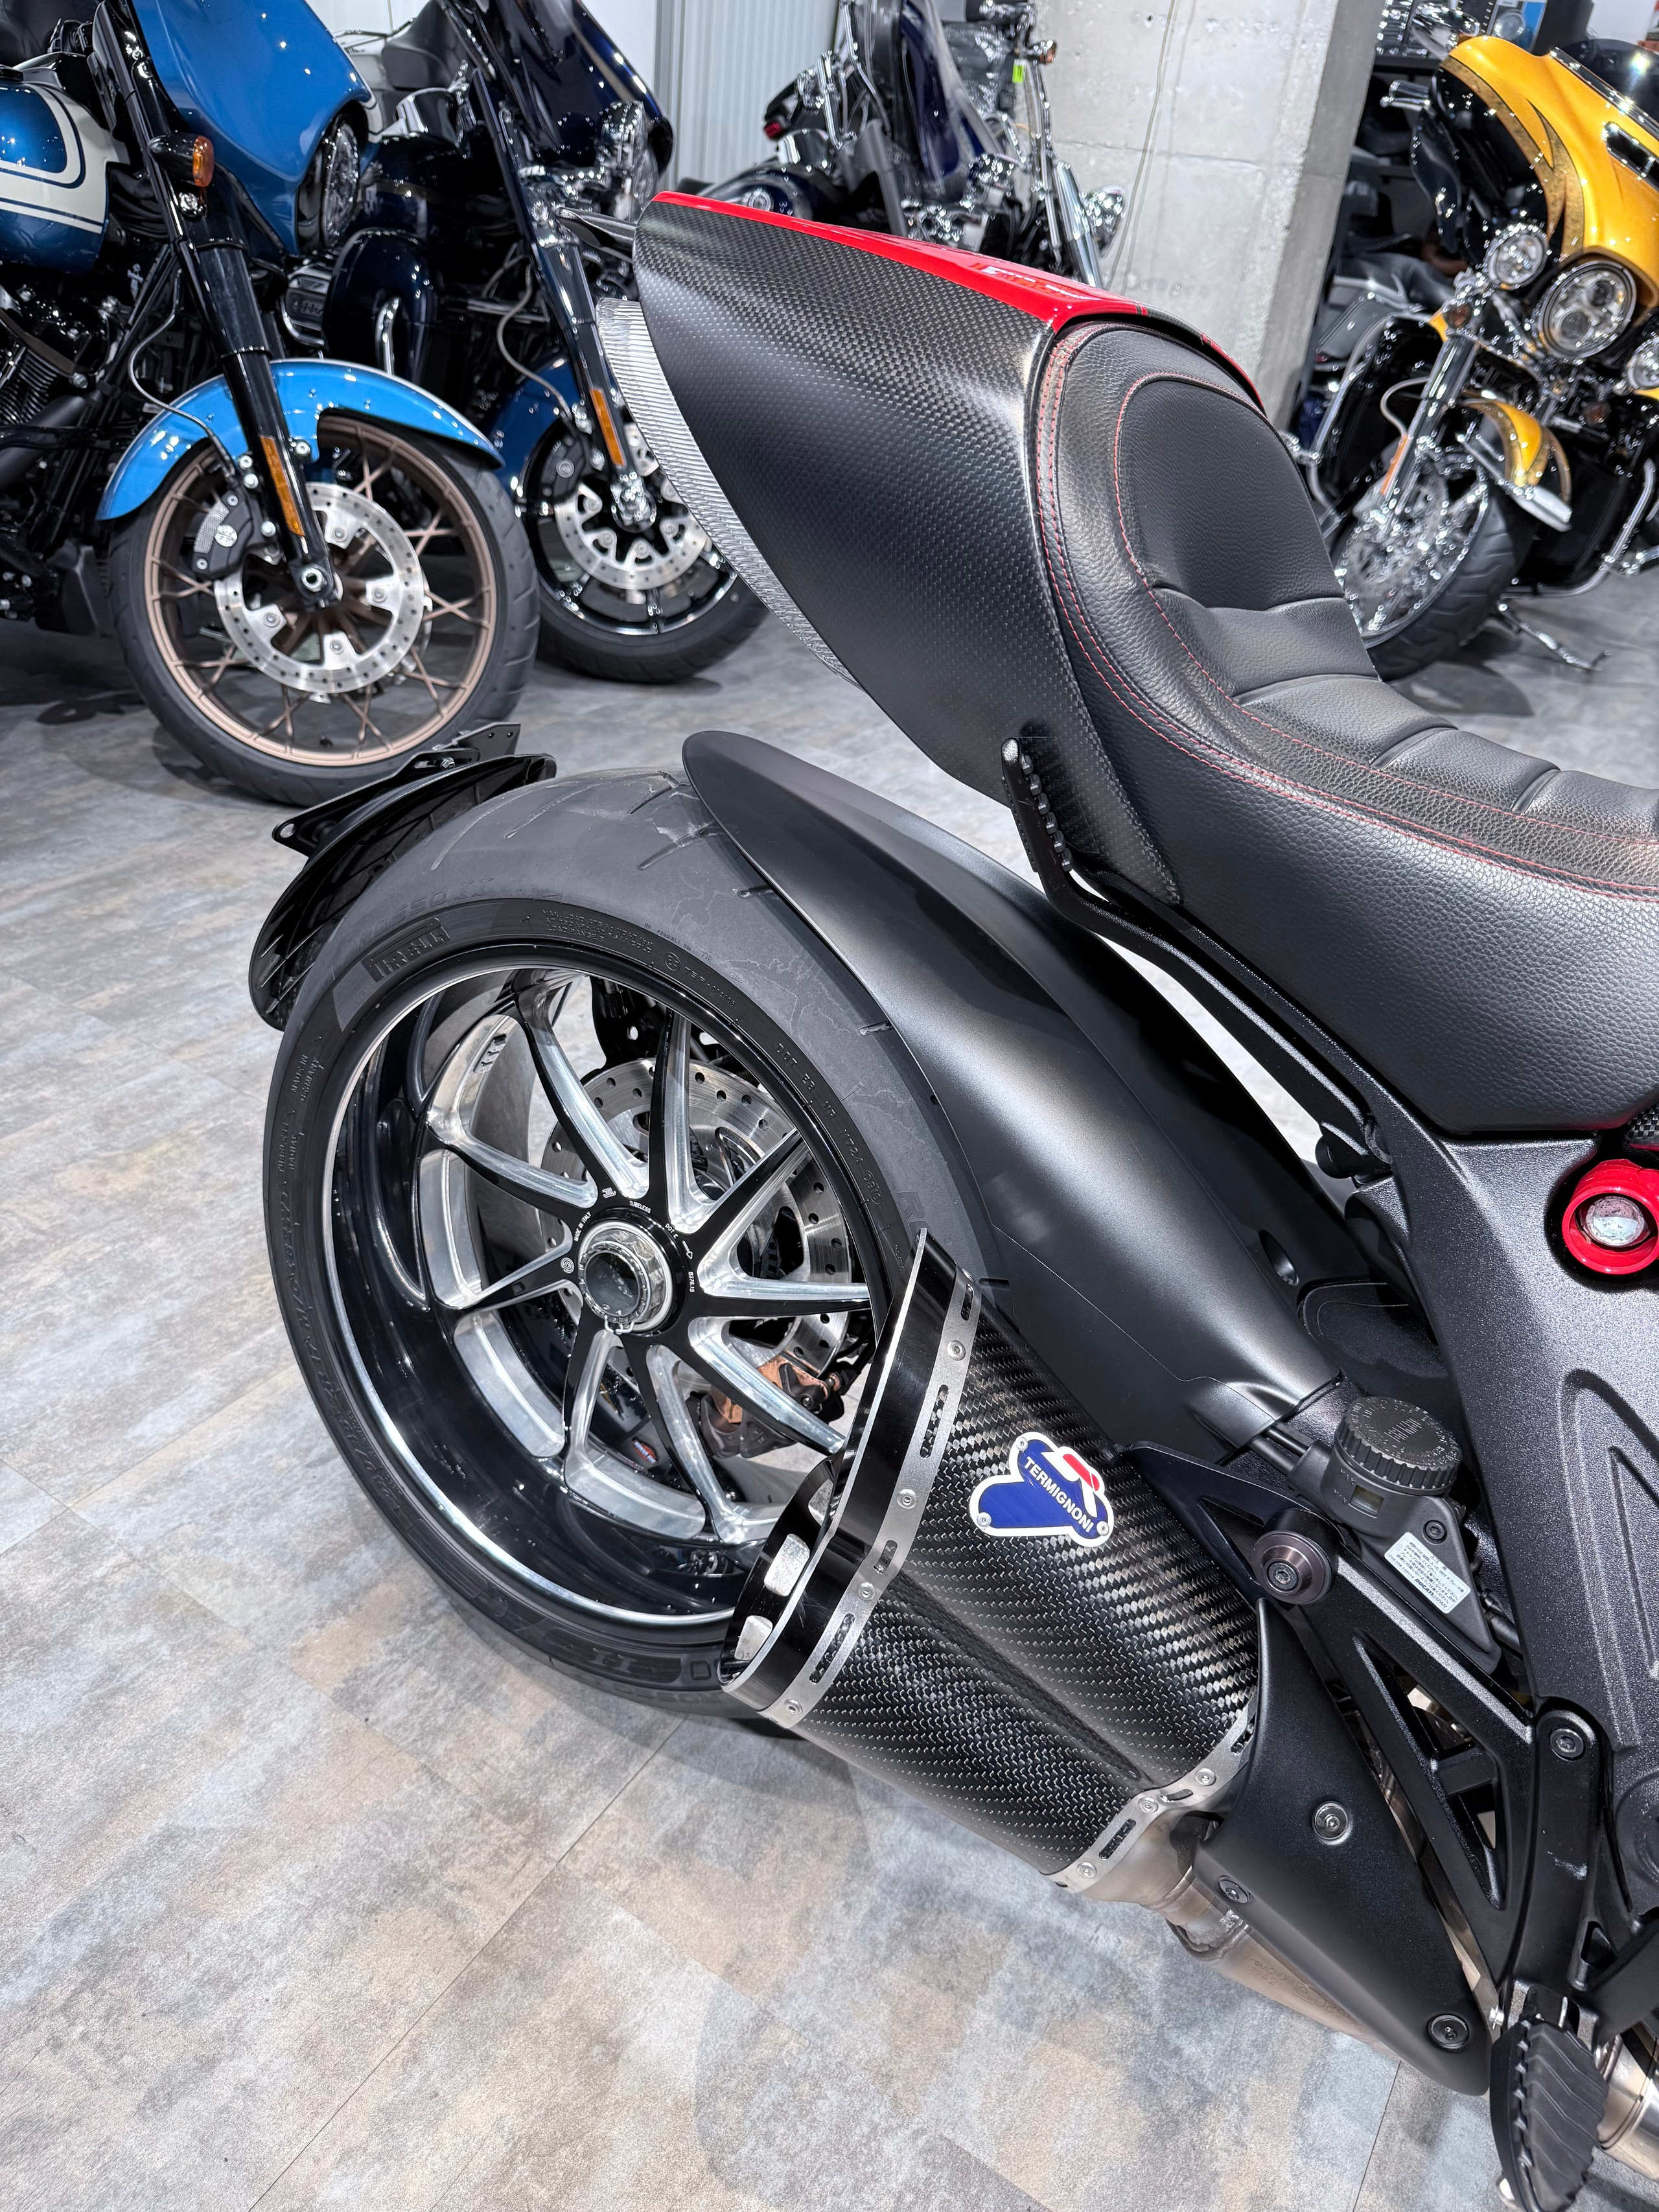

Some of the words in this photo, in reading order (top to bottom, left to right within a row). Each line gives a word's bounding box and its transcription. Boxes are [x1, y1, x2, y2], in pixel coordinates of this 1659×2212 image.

[358, 891, 447, 951] ROSSO
[454, 878, 494, 902] II
[361, 916, 452, 982] PIRELLI
[574, 1228, 582, 1242] MADE
[581, 1211, 592, 1224] ITALY
[629, 1200, 651, 1214] TUBELESS
[665, 1222, 675, 1235] DOT
[1023, 1456, 1094, 1533] TERMIGNONI
